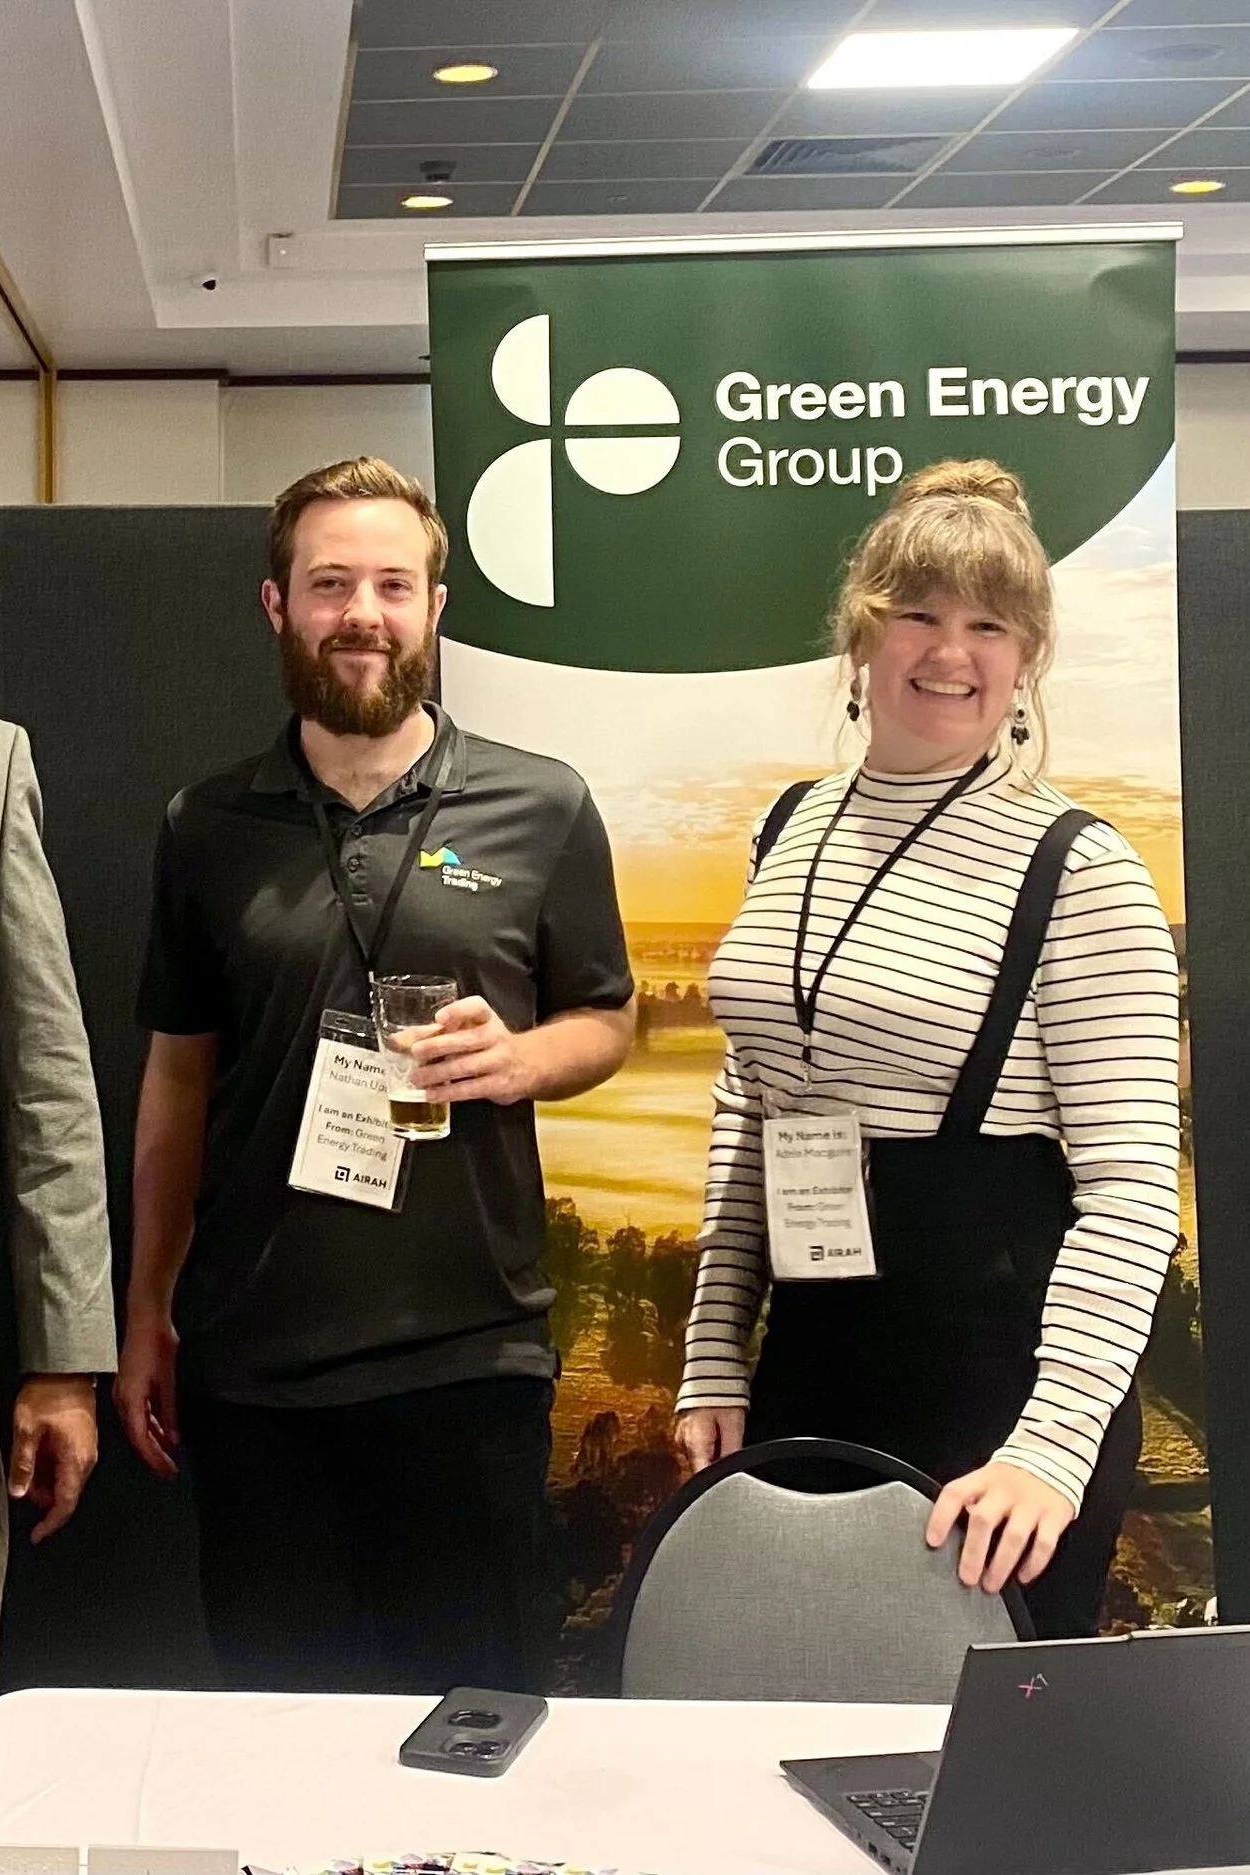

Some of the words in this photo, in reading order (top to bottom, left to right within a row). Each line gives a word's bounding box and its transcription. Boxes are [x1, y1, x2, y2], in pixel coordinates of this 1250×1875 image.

[715, 371, 906, 422] Green
[928, 367, 1150, 426] Energy
[717, 436, 904, 496] Group
[442, 865, 470, 878] Green
[471, 869, 502, 887] Energy
[442, 874, 478, 892] Trading
[334, 1055, 350, 1069] My
[329, 1070, 367, 1090] Nathan
[324, 1107, 339, 1117] am
[341, 1110, 354, 1120] an
[325, 1121, 354, 1136] From:
[355, 1128, 385, 1144] Green
[778, 1131, 793, 1144] My
[796, 1131, 830, 1141] Name
[317, 1134, 350, 1152] Energy
[352, 1141, 389, 1162] Trading
[352, 1173, 387, 1189] AIRAH
